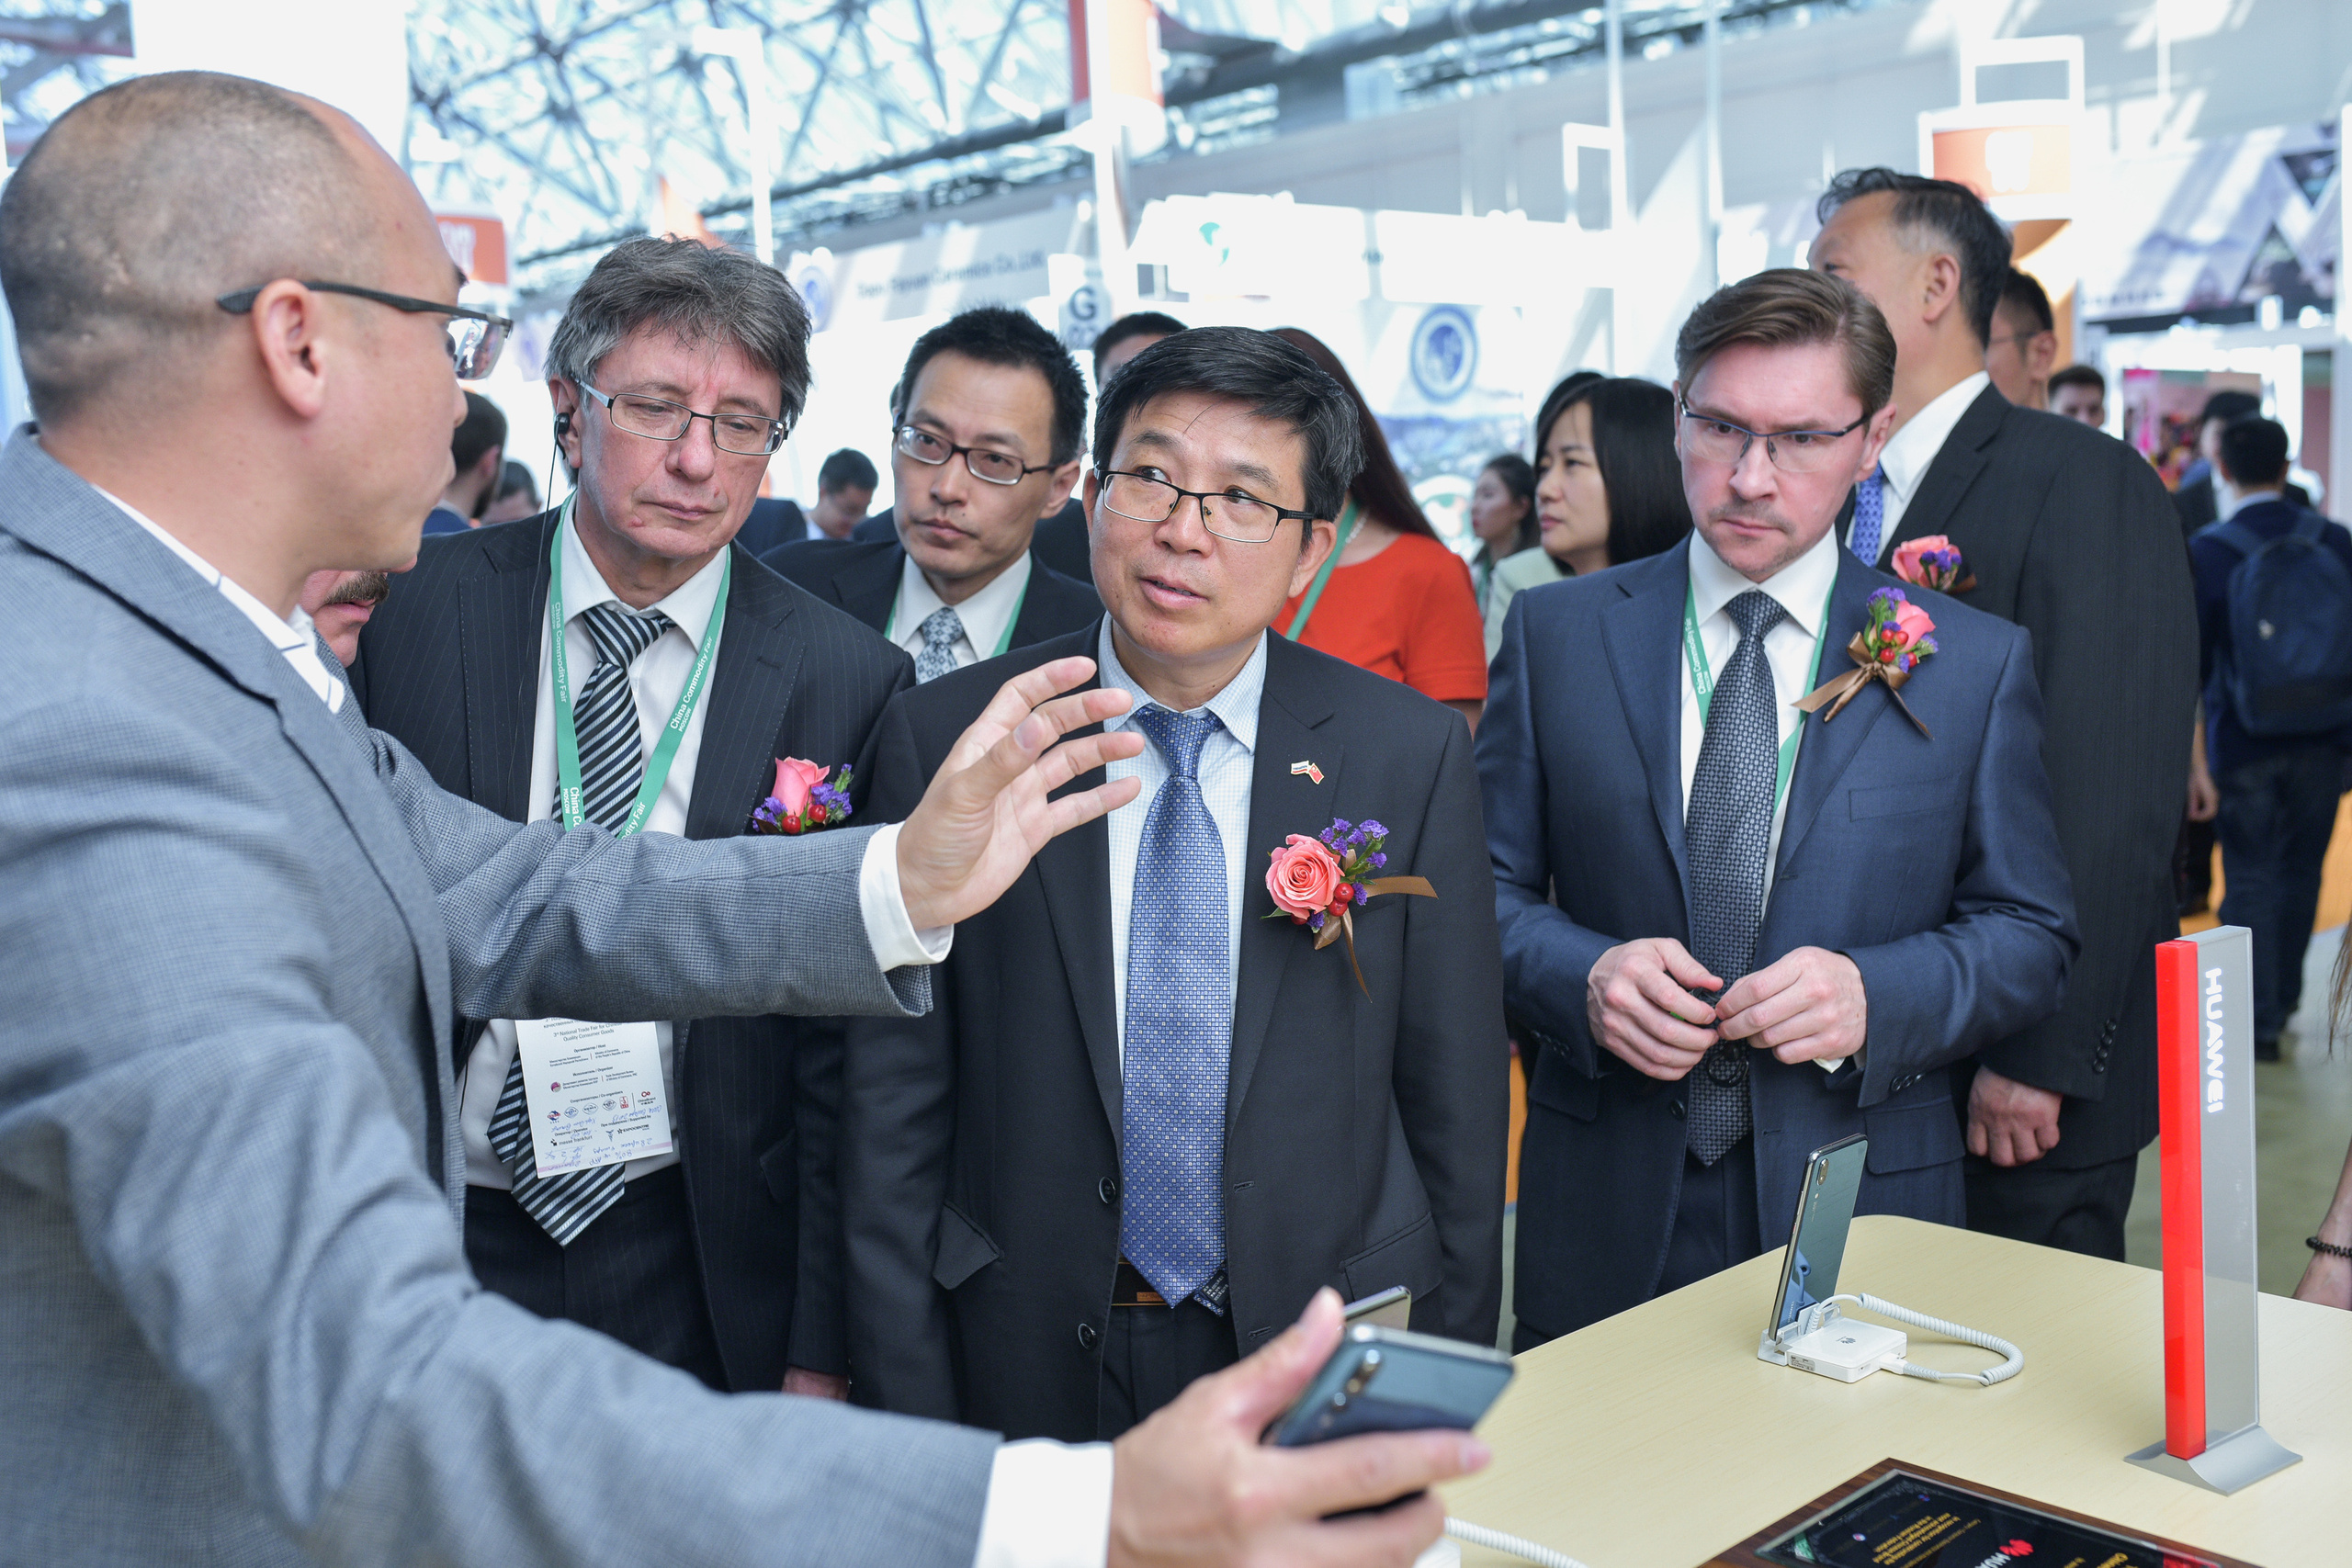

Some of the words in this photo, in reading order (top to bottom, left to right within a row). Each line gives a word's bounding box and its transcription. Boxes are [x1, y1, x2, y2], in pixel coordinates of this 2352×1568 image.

[1069, 285, 1097, 321] G
[556, 630, 565, 684] Commodity
[1686, 630, 1702, 672] Commodity
[560, 685, 568, 703] Fair
[670, 703, 686, 729] China
[683, 650, 709, 705] Commodity
[1696, 672, 1706, 694] China
[678, 708, 691, 732] MOSCOW
[570, 787, 580, 814] China
[632, 801, 646, 820] Fair
[2205, 967, 2224, 1113] HUAWEI
